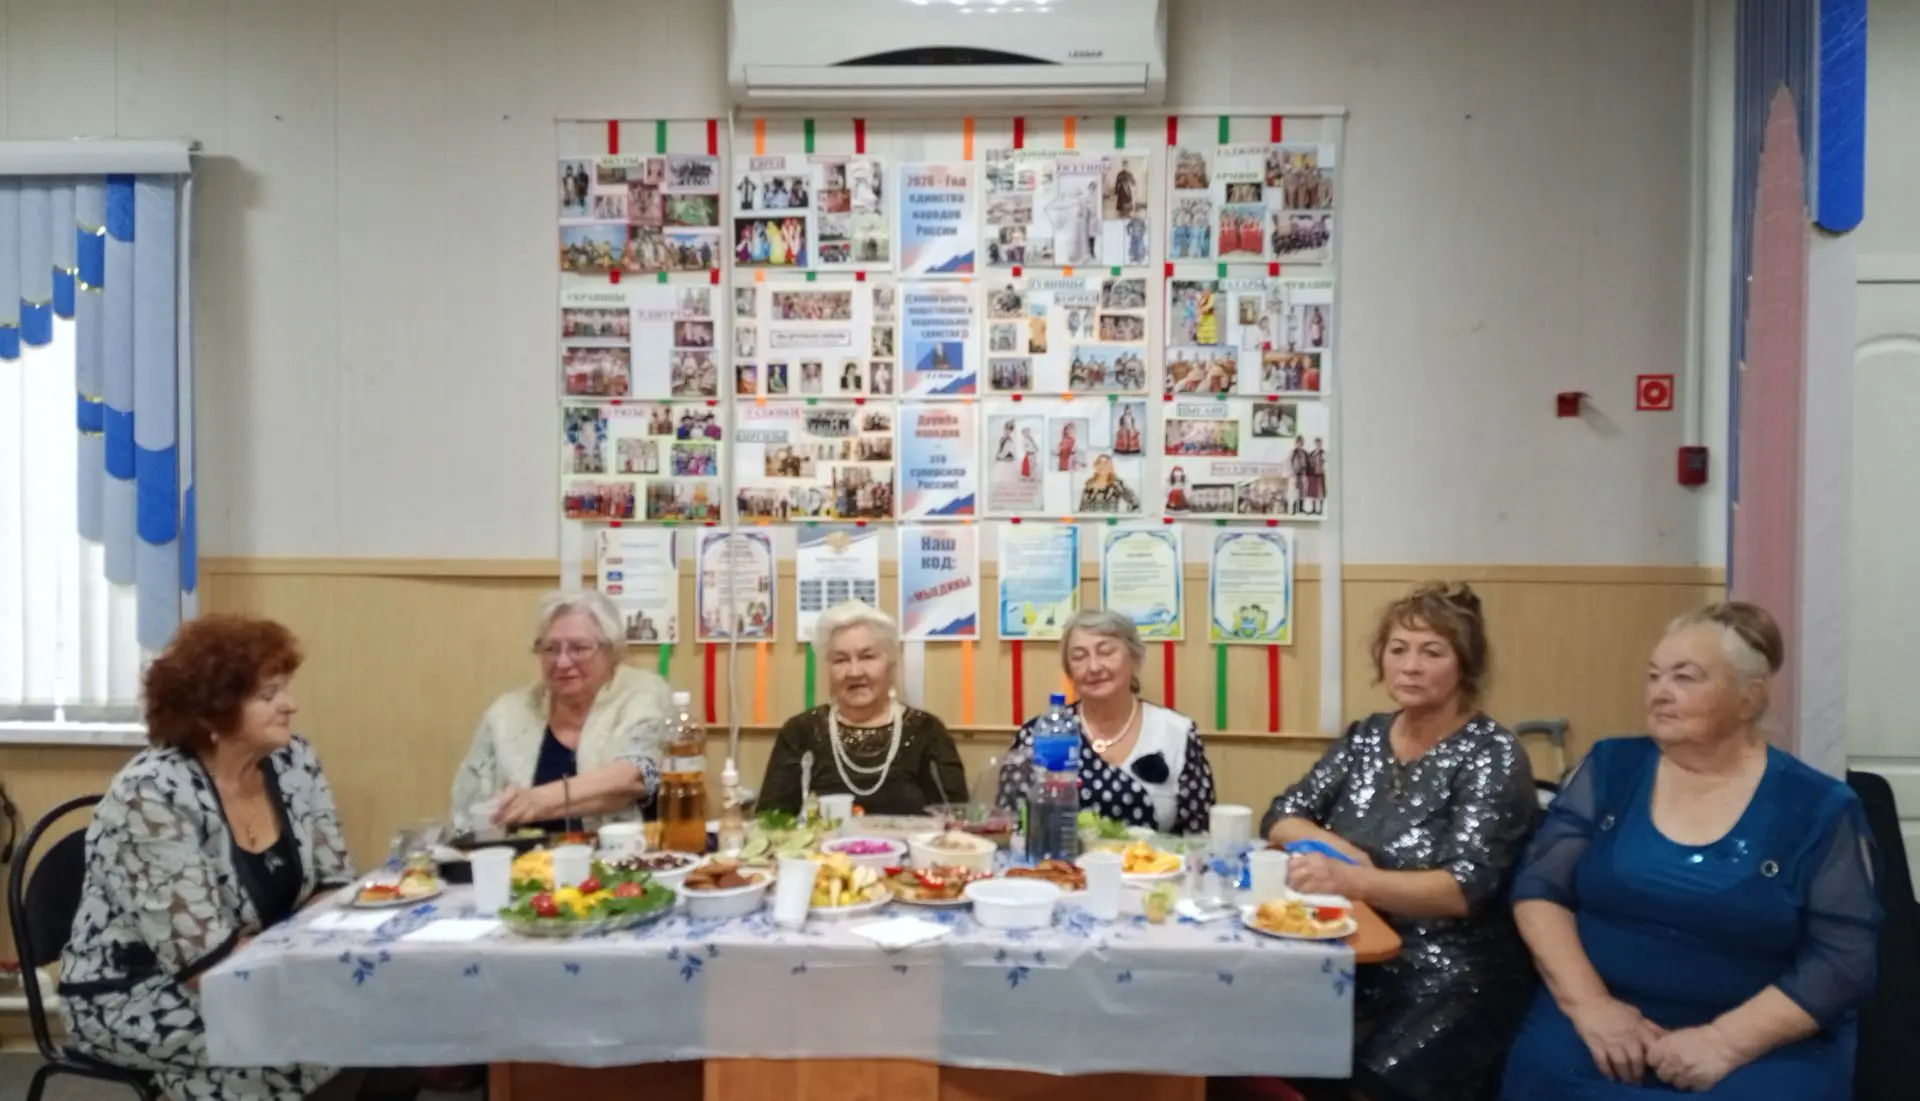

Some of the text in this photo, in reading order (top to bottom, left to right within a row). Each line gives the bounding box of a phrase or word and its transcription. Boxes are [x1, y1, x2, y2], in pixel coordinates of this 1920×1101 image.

[945, 175, 967, 188] Год
[909, 194, 964, 204] единства
[912, 210, 961, 220] народов
[916, 225, 957, 236] России
[917, 414, 959, 427] Дружба
[914, 429, 960, 439] народов
[921, 536, 956, 551] Наш
[921, 556, 956, 571] код:
